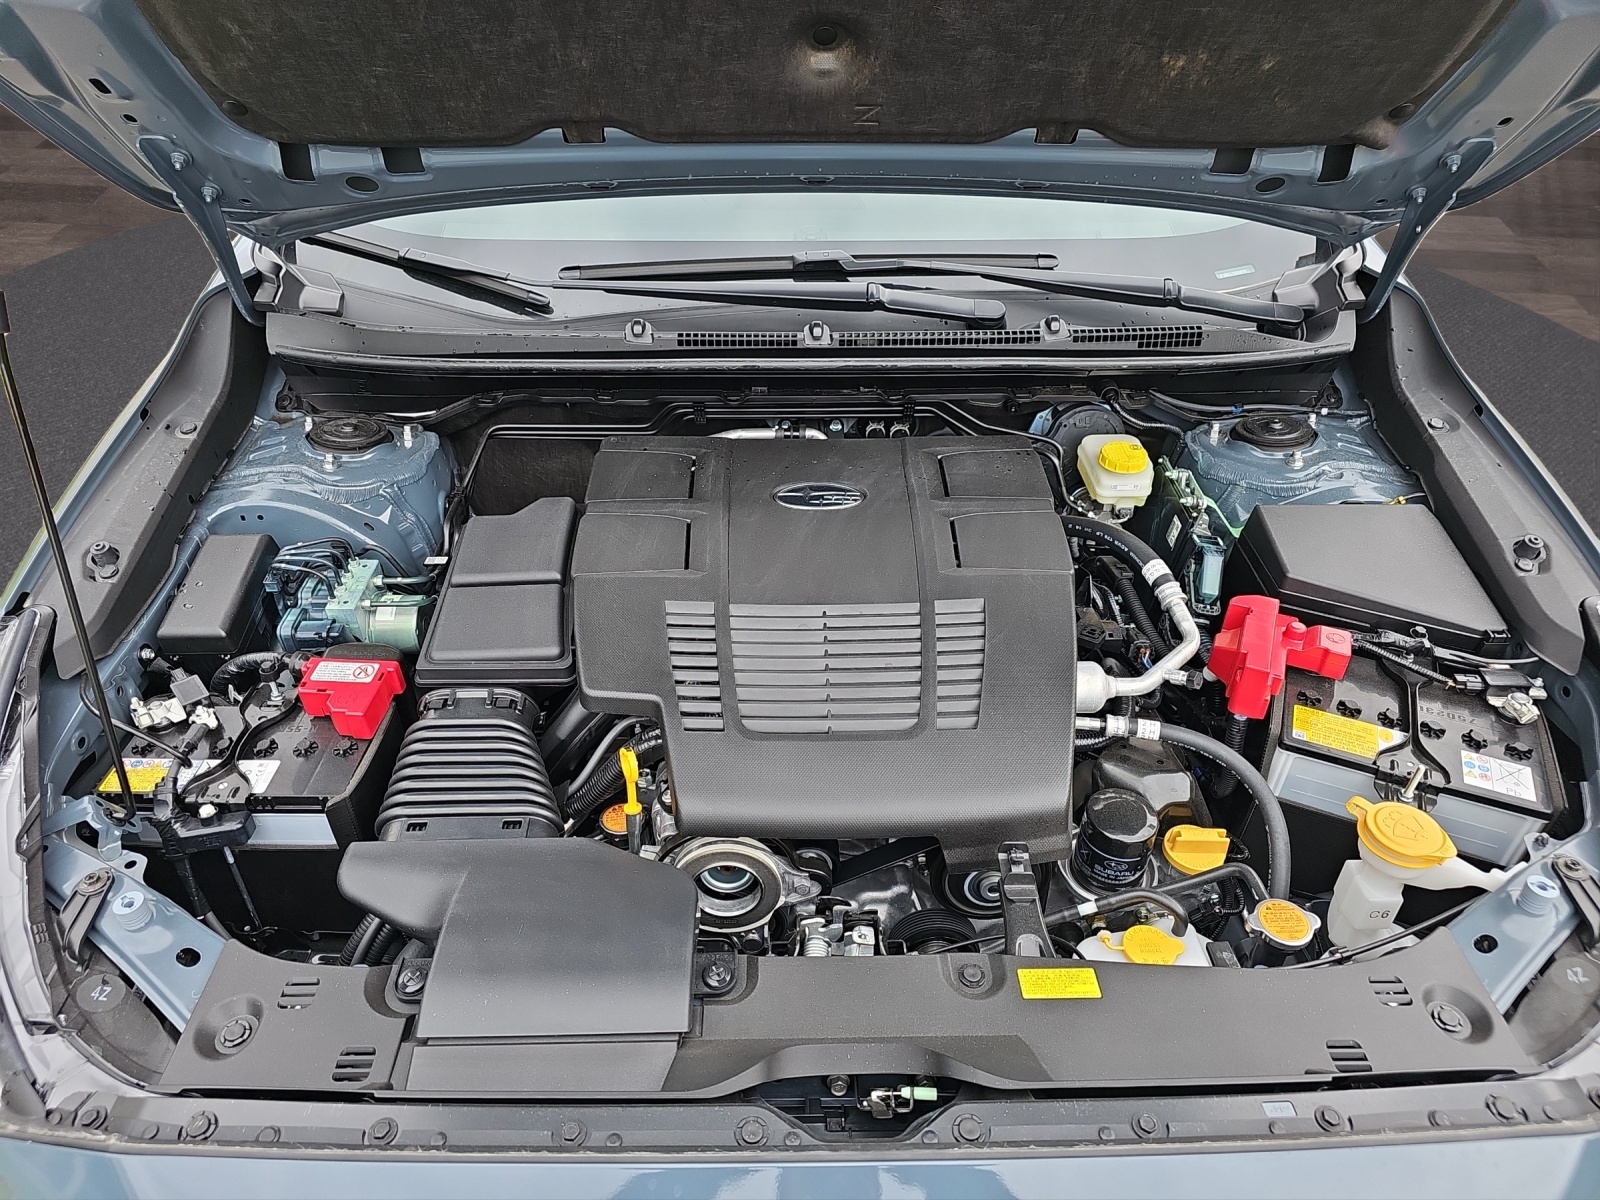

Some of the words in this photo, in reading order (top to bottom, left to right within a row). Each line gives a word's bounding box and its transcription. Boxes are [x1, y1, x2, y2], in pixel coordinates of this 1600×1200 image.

[1506, 787, 1522, 796] Pb
[1094, 864, 1134, 876] SUBARU
[1370, 910, 1390, 918] C6
